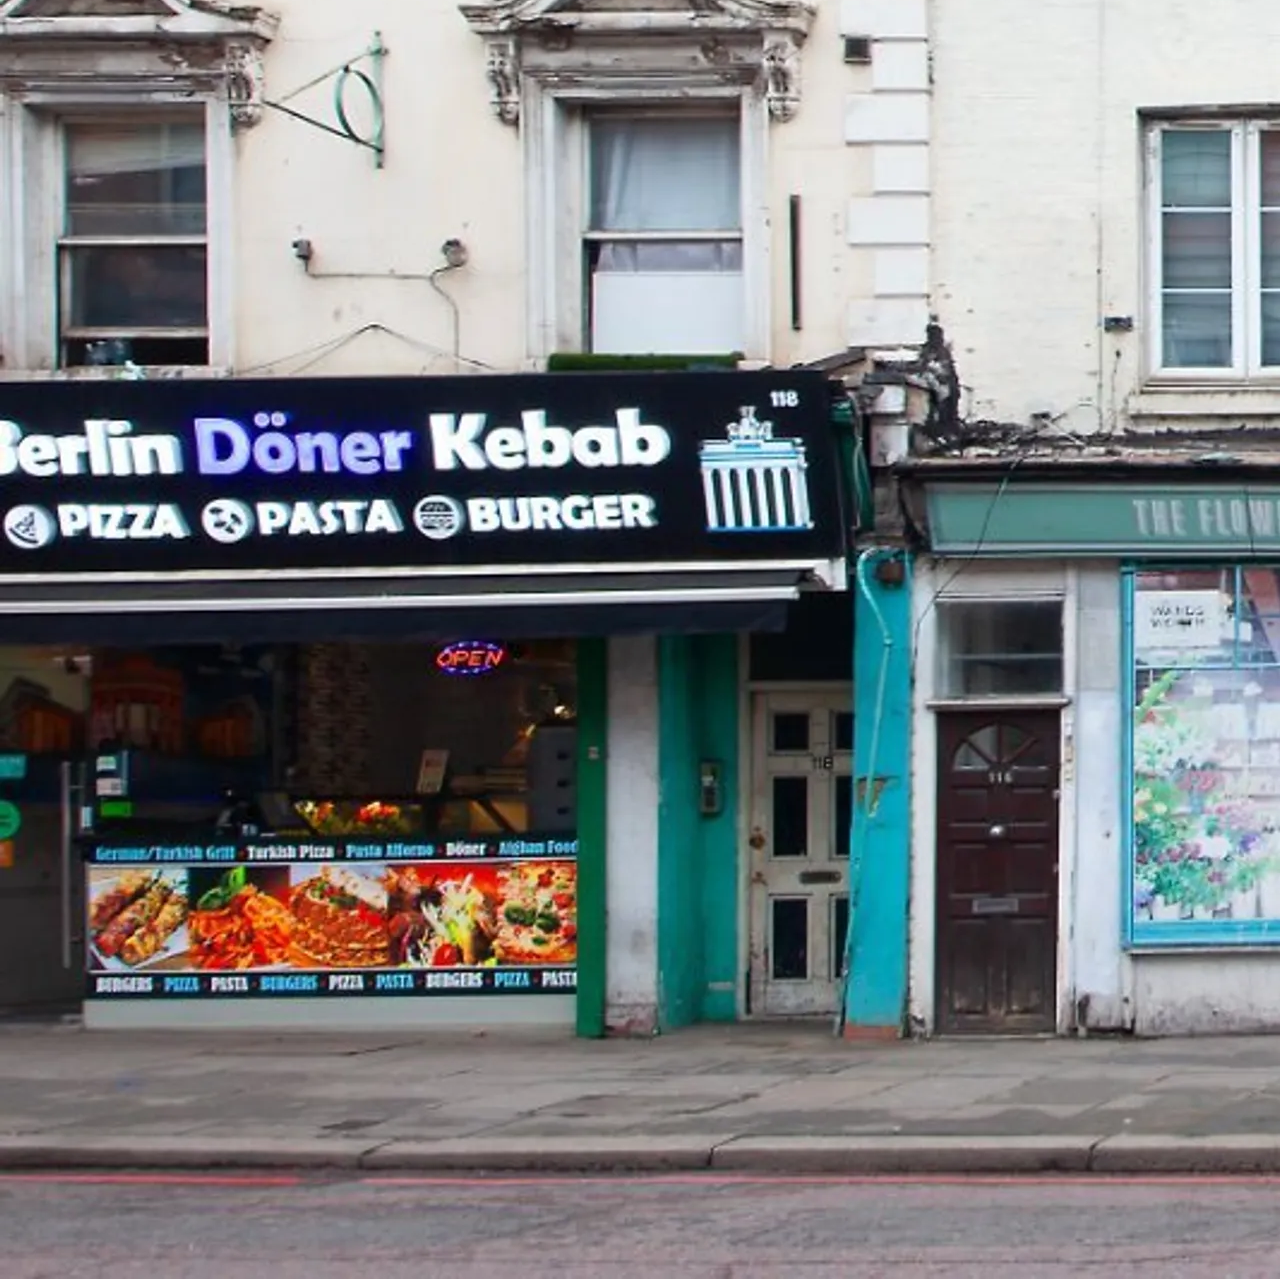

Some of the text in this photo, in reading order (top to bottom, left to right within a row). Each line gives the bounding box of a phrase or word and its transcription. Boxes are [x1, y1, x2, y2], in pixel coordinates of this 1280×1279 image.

[770, 391, 799, 407] 118
[194, 411, 412, 475] Döner
[428, 408, 671, 470] Kebab
[56, 494, 658, 539] PIZZA PASTA BURGER
[1132, 499, 1187, 538] THE
[436, 650, 504, 667] OPEN
[246, 845, 296, 860] Turkish
[299, 844, 335, 859] Pizza
[446, 841, 487, 857] Döner
[96, 977, 153, 993] BURGERS
[163, 977, 199, 993] PIZZA
[211, 976, 249, 992] PASTA
[260, 975, 318, 991] BURGERS
[329, 974, 364, 990] PIZZA
[376, 974, 415, 989] PASTA
[426, 972, 483, 988] BURGERS
[494, 972, 530, 987] PIZZA
